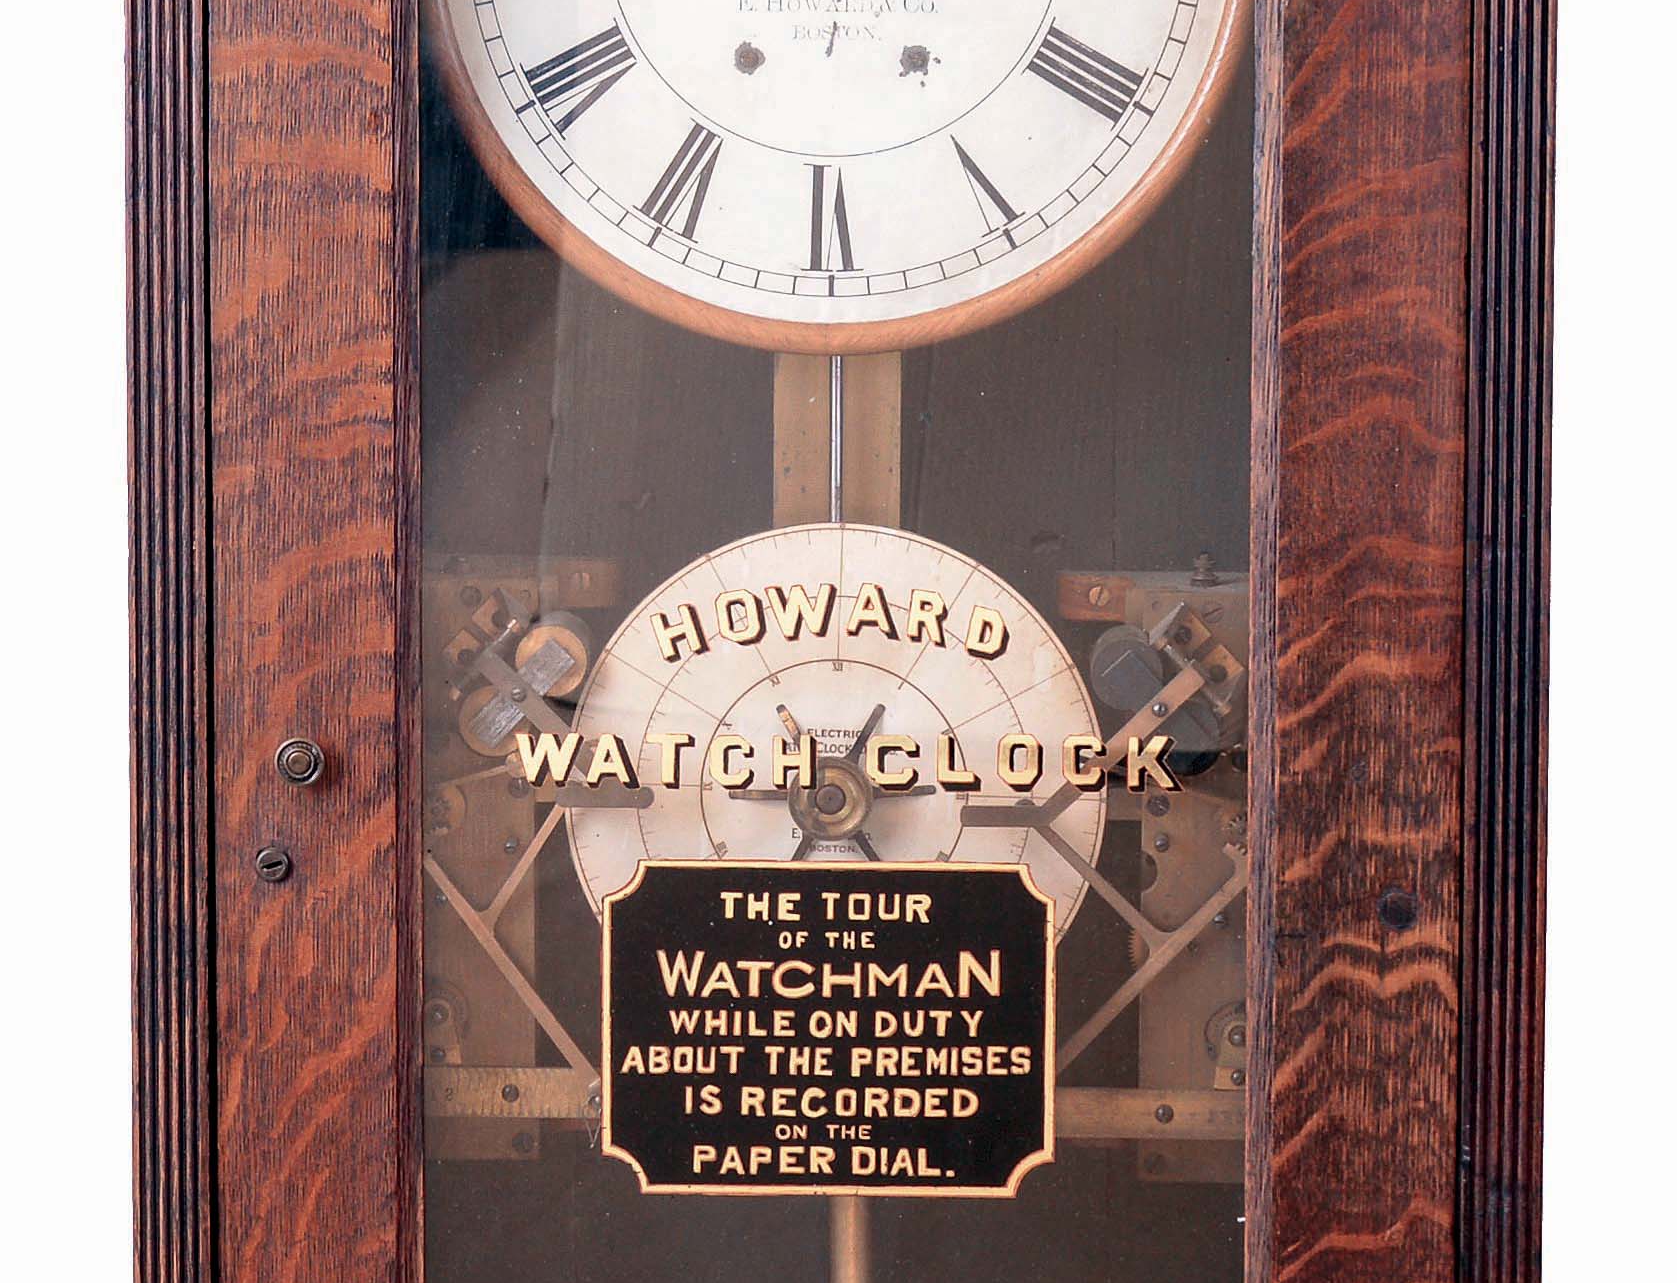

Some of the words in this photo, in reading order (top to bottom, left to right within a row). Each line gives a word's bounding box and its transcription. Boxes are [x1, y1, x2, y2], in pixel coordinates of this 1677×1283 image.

[521, 18, 636, 140] VIII
[1022, 18, 1149, 129] IIII
[632, 119, 722, 243] VII
[950, 135, 1025, 238] V
[800, 164, 863, 272] VI
[650, 583, 1010, 664] HOWARD
[515, 732, 818, 792] WATCH
[864, 733, 1186, 793] CLOCK
[720, 891, 801, 922] THE
[821, 892, 932, 924] TOUR
[778, 930, 809, 950] OF
[824, 930, 876, 950] THE
[656, 949, 1001, 998] WATCHMAN
[669, 1009, 796, 1038] WHILE
[809, 1010, 858, 1038] ON
[874, 1010, 983, 1038] DUTY
[620, 1046, 745, 1075] ABOUT
[764, 1046, 833, 1076] THE
[850, 1045, 1032, 1077] PREMISES
[684, 1084, 723, 1115] IS
[740, 1086, 980, 1118] RECORDED
[775, 1123, 808, 1141] ON
[826, 1124, 872, 1141] THE
[692, 1145, 836, 1175] PAPER
[851, 1147, 955, 1178] DIAL.
